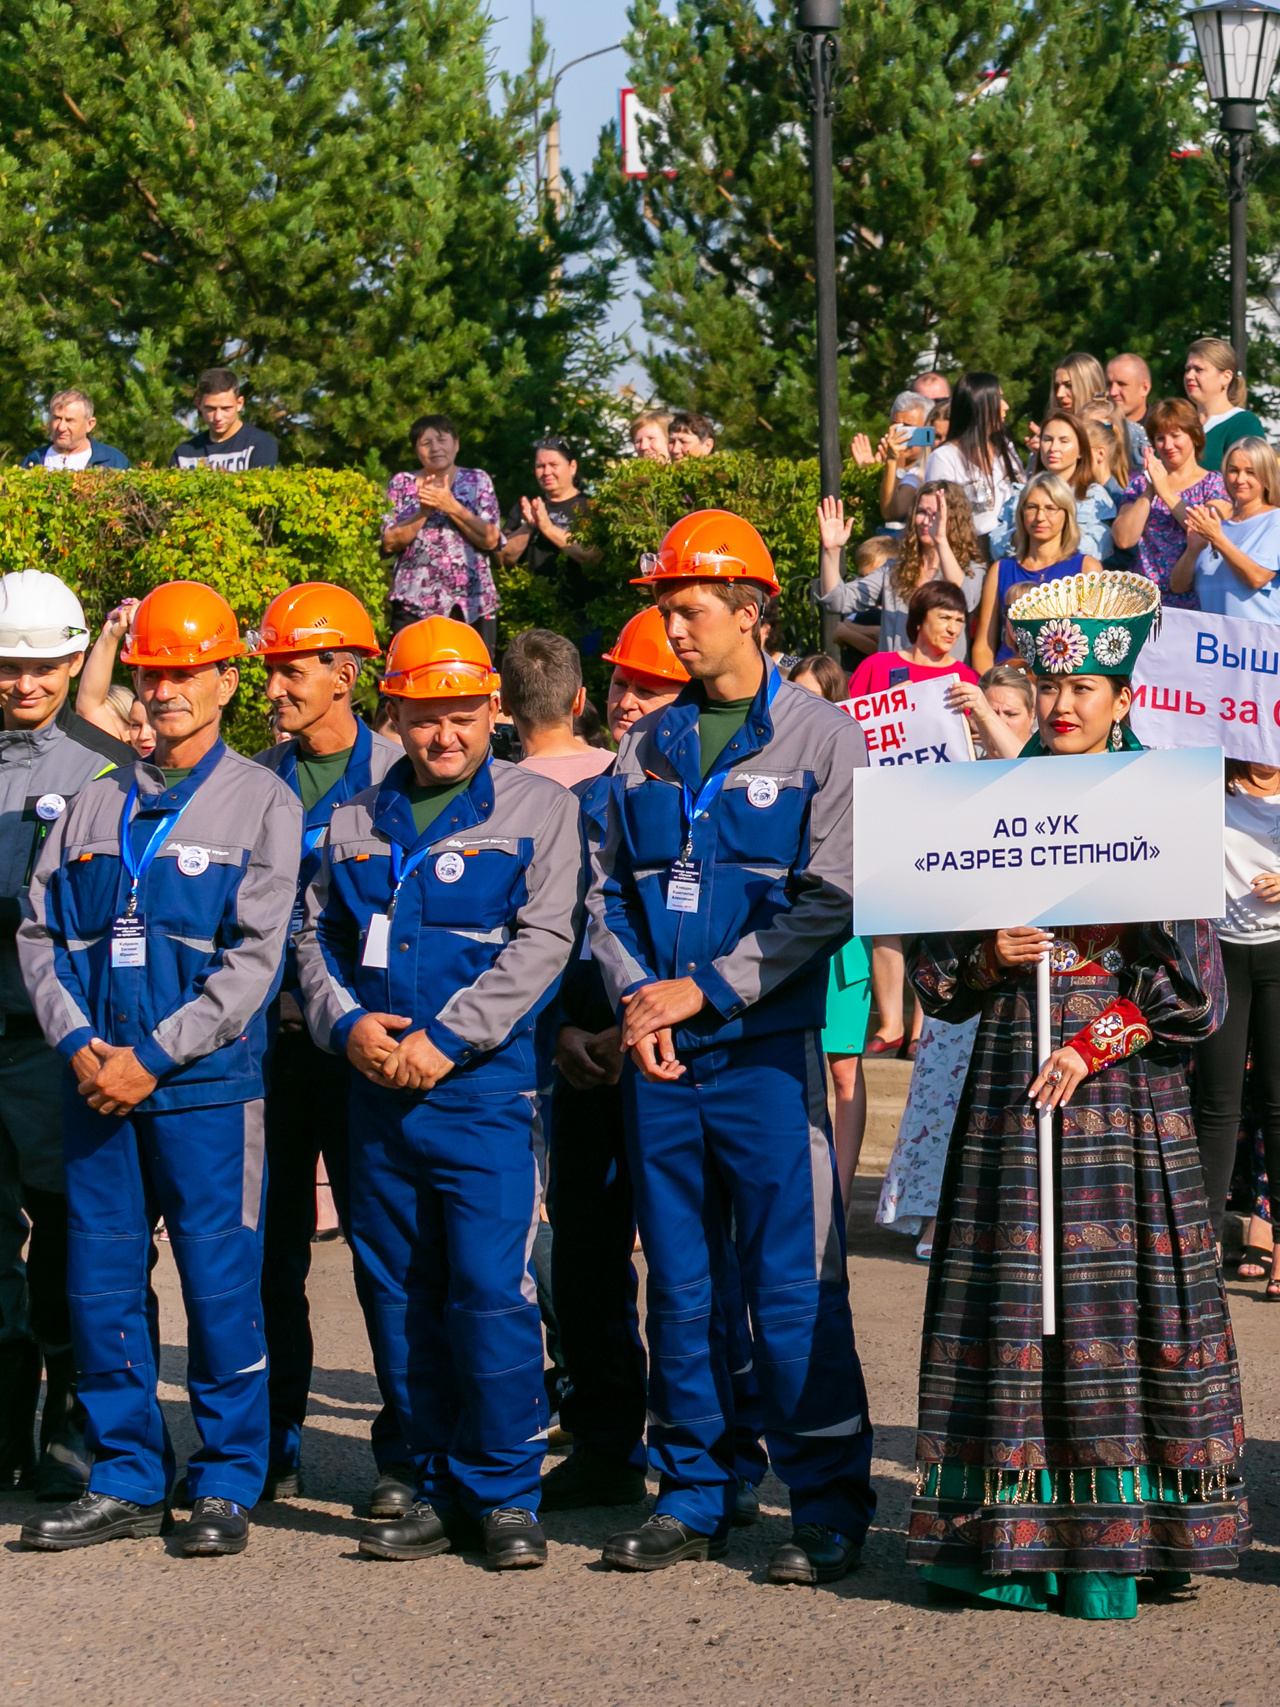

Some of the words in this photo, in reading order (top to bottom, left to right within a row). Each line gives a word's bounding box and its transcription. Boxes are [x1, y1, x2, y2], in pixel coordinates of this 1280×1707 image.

[1219, 697, 1258, 725] за
[993, 817, 1027, 838] АО
[1034, 814, 1079, 836] «УК
[914, 848, 1022, 872] «РАЗРЕЗ
[1031, 836, 1160, 867] СТЕПНОЙ»
